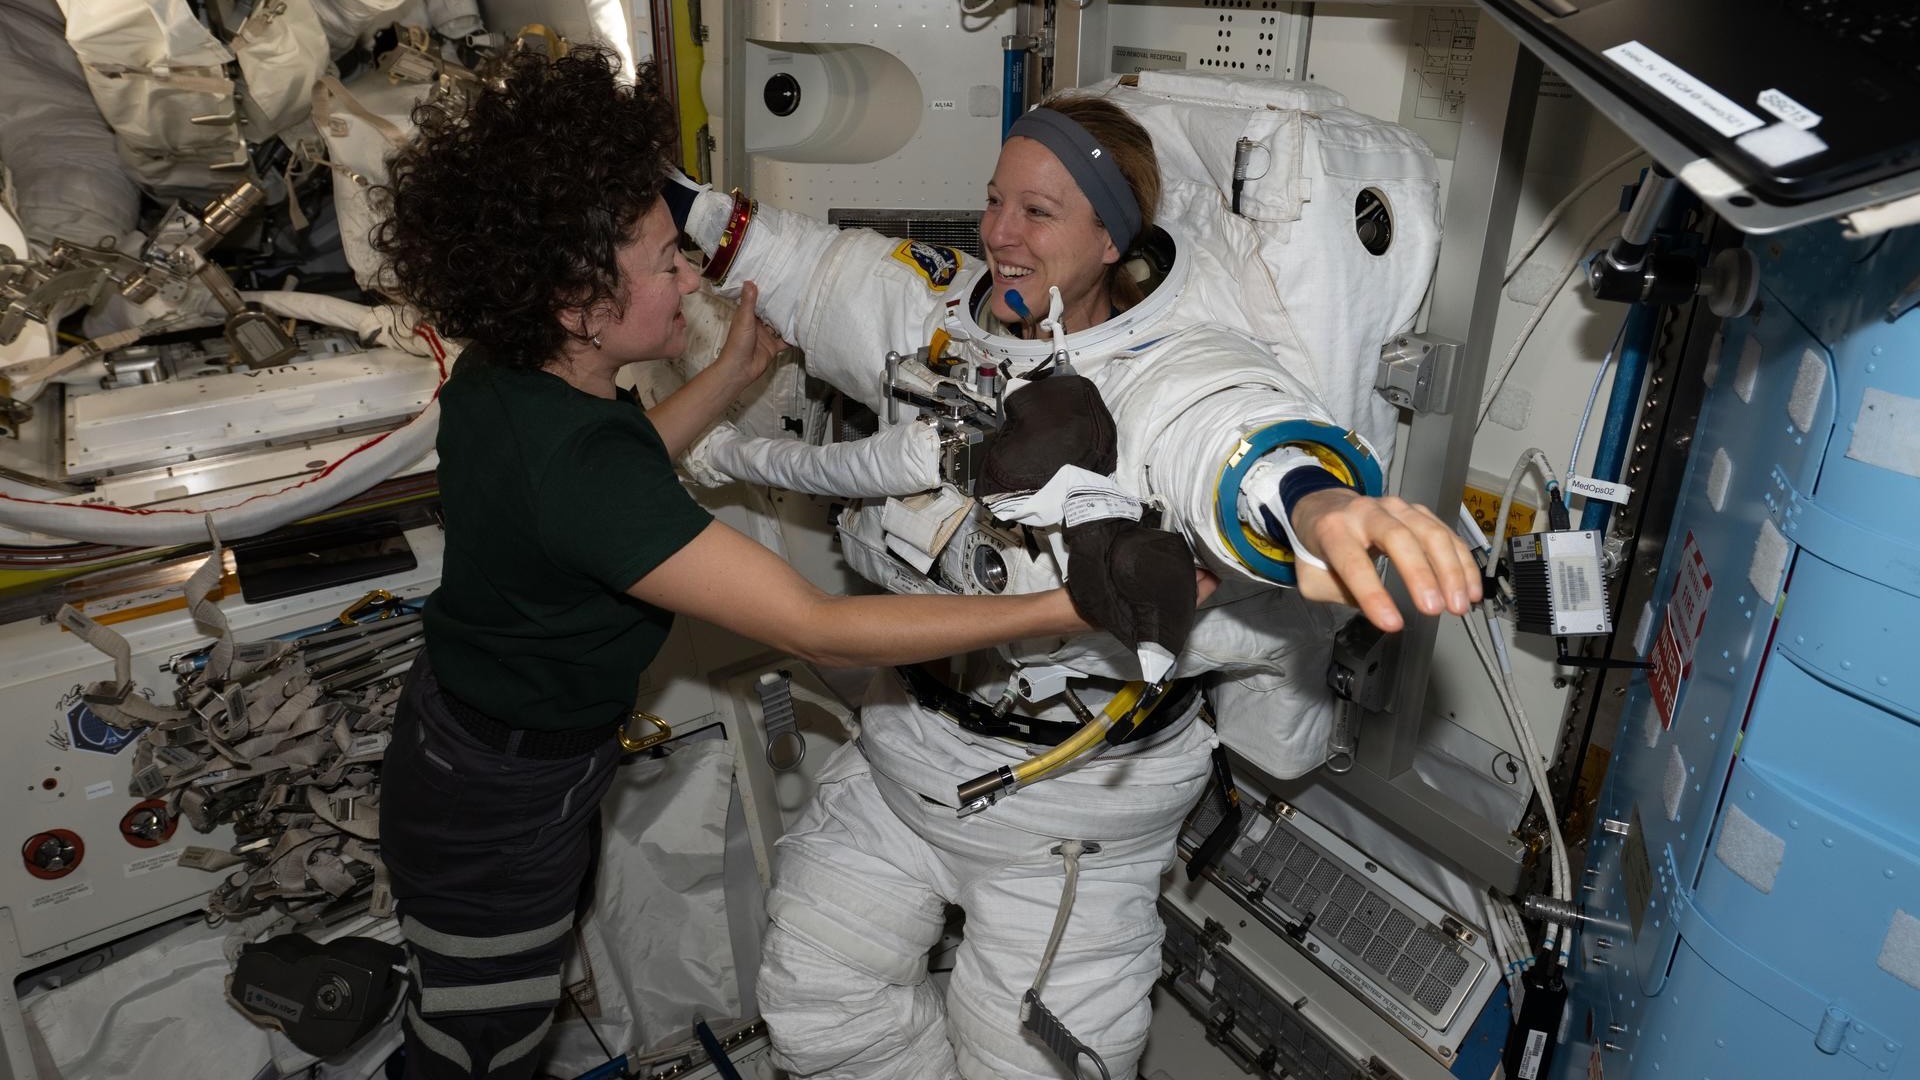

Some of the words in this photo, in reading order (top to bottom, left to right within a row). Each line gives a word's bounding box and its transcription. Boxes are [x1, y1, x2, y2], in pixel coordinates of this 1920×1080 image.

[1127, 51, 1148, 59] REMOVAL
[1150, 53, 1182, 62] RECEPTACLE
[176, 216, 193, 230] 2
[1571, 480, 1615, 496] MedOps02
[1682, 585, 1696, 622] FIRE
[1661, 622, 1678, 683] WATER
[1660, 675, 1674, 719] PFE
